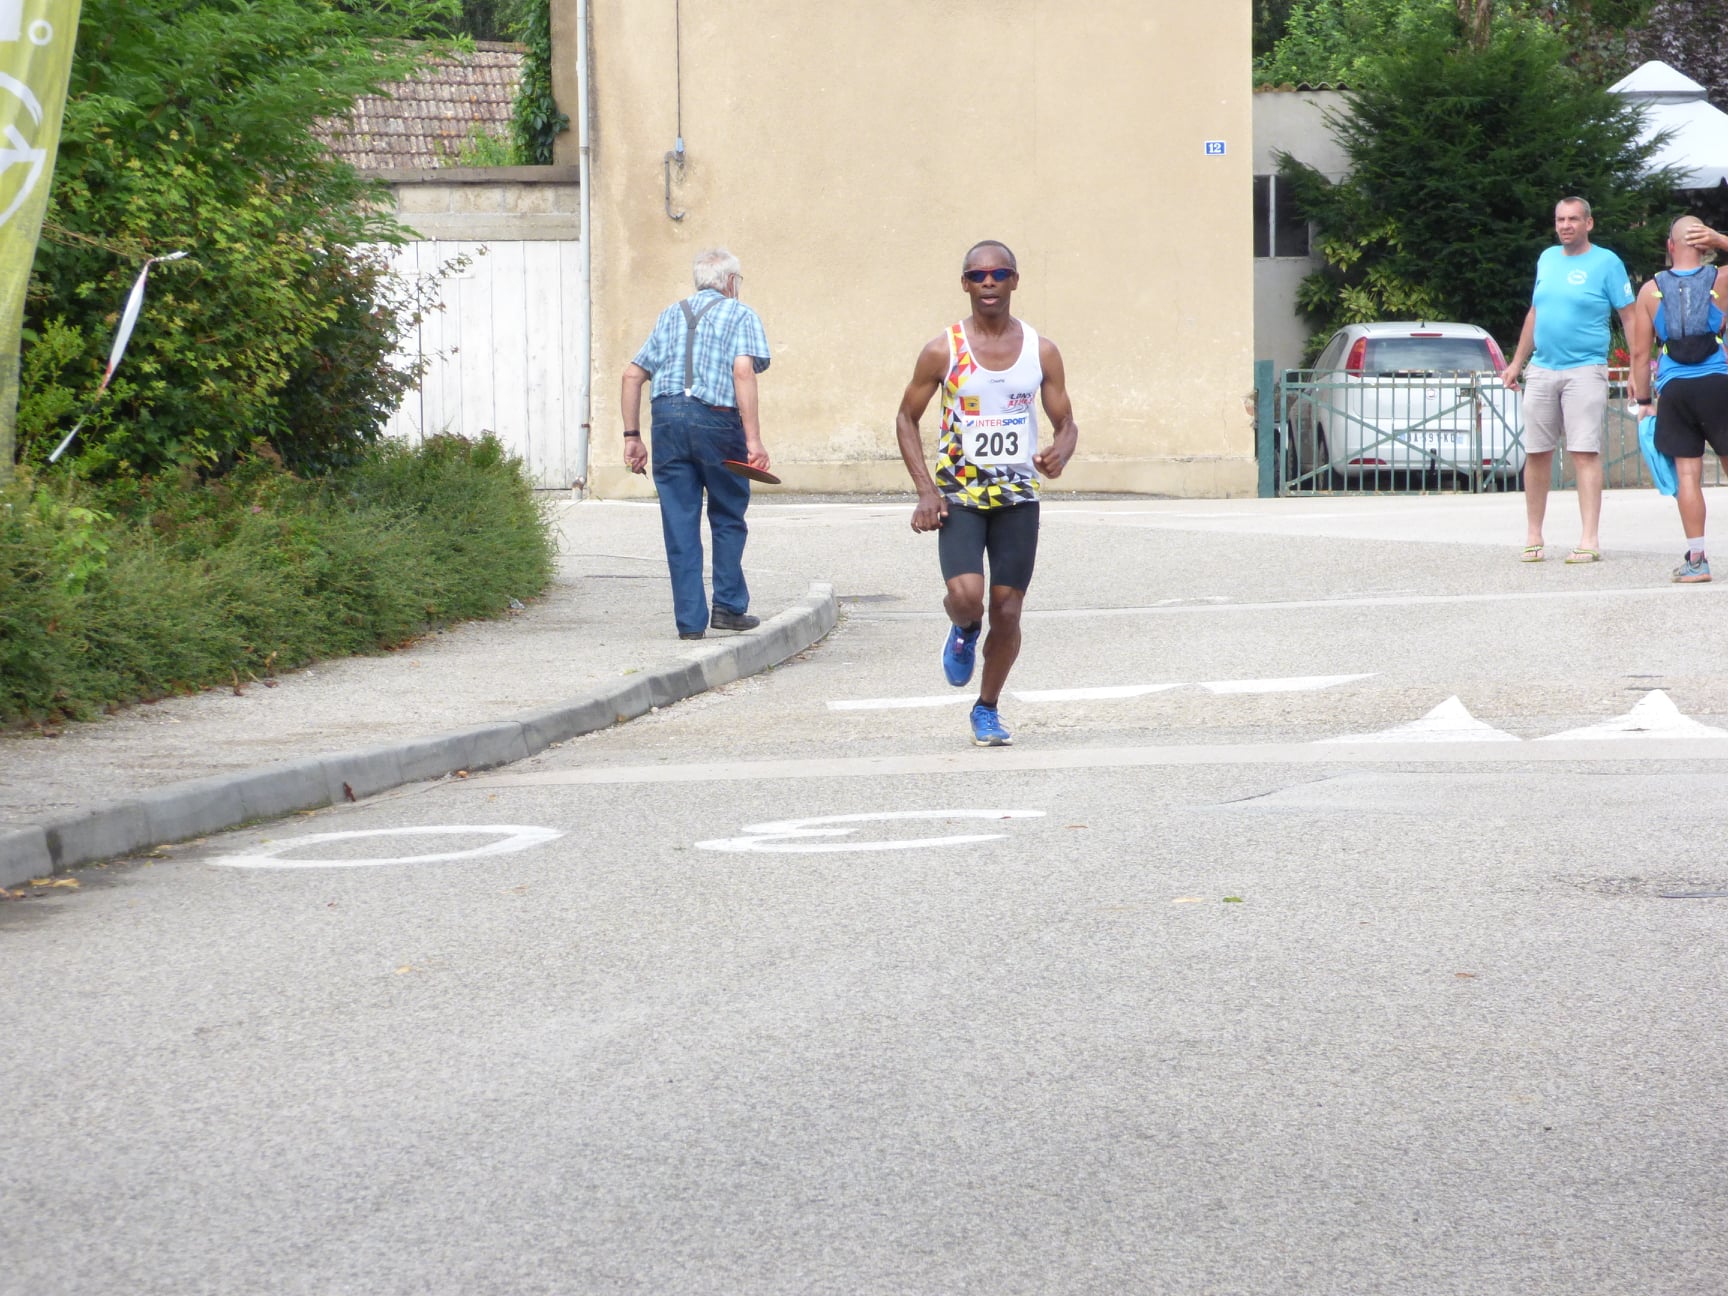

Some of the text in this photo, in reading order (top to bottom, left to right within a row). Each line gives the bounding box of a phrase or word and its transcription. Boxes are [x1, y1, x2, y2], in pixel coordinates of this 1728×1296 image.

[1209, 143, 1221, 153] 12
[975, 417, 1026, 427] INTERSPORT
[975, 431, 1019, 457] 203
